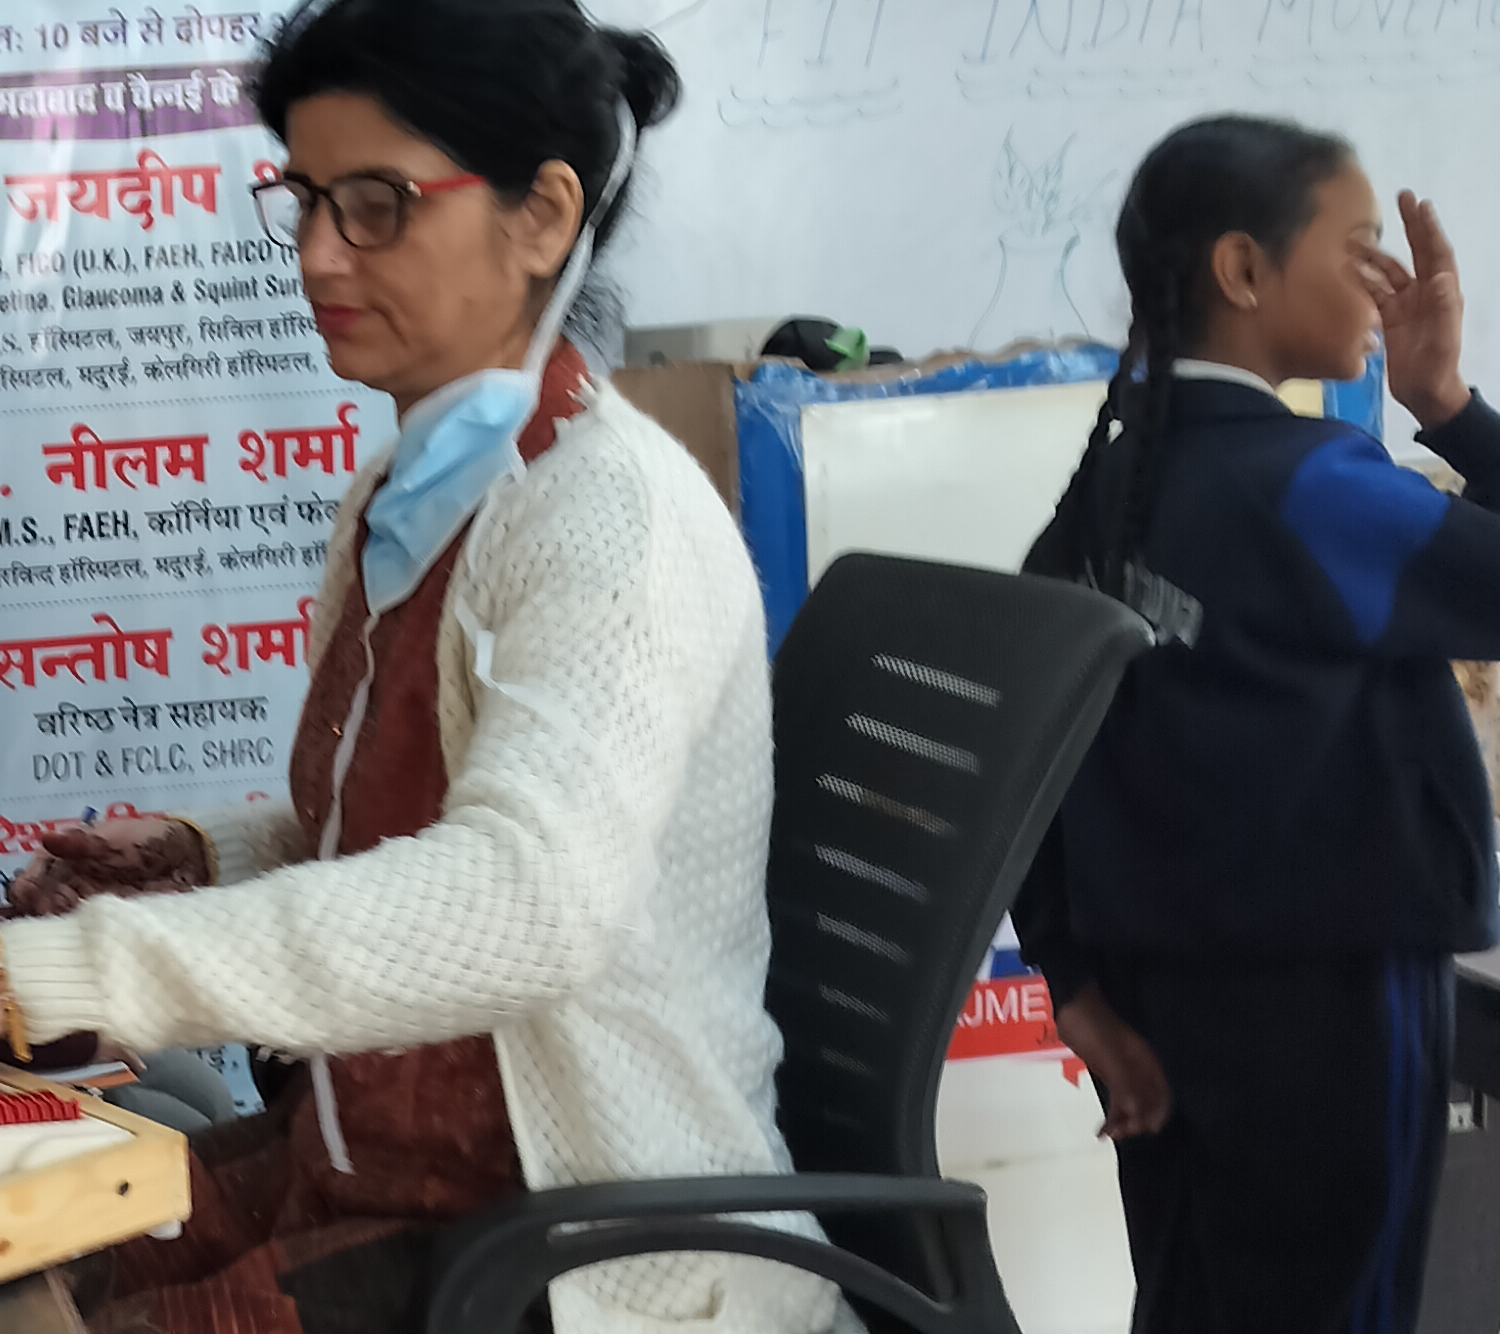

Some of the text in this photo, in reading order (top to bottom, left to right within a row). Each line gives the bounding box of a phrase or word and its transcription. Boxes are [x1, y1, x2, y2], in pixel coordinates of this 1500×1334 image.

[34, 22, 70, 51] 10
[77, 6, 129, 46] बजे
[136, 5, 165, 46] से
[172, 4, 262, 47] दोपहर
[3, 147, 221, 232] जयदीप
[16, 249, 66, 278] FICO
[210, 238, 273, 267] FAICO
[62, 281, 165, 312] Glaucoma
[170, 278, 187, 305] &
[194, 273, 259, 309] Squint
[198, 314, 266, 344] सिविल
[42, 422, 210, 495] नीलम
[238, 400, 360, 483] शर्मा
[143, 496, 243, 537] कॉर्निया
[245, 493, 291, 536] एवं
[201, 597, 316, 676] शर्मा
[33, 695, 269, 739] वरिष्ठ नेत्र सहायक
[32, 750, 86, 784] DOT
[95, 747, 113, 780] &
[201, 736, 275, 772] SHRC
[956, 983, 1048, 1029] JME
